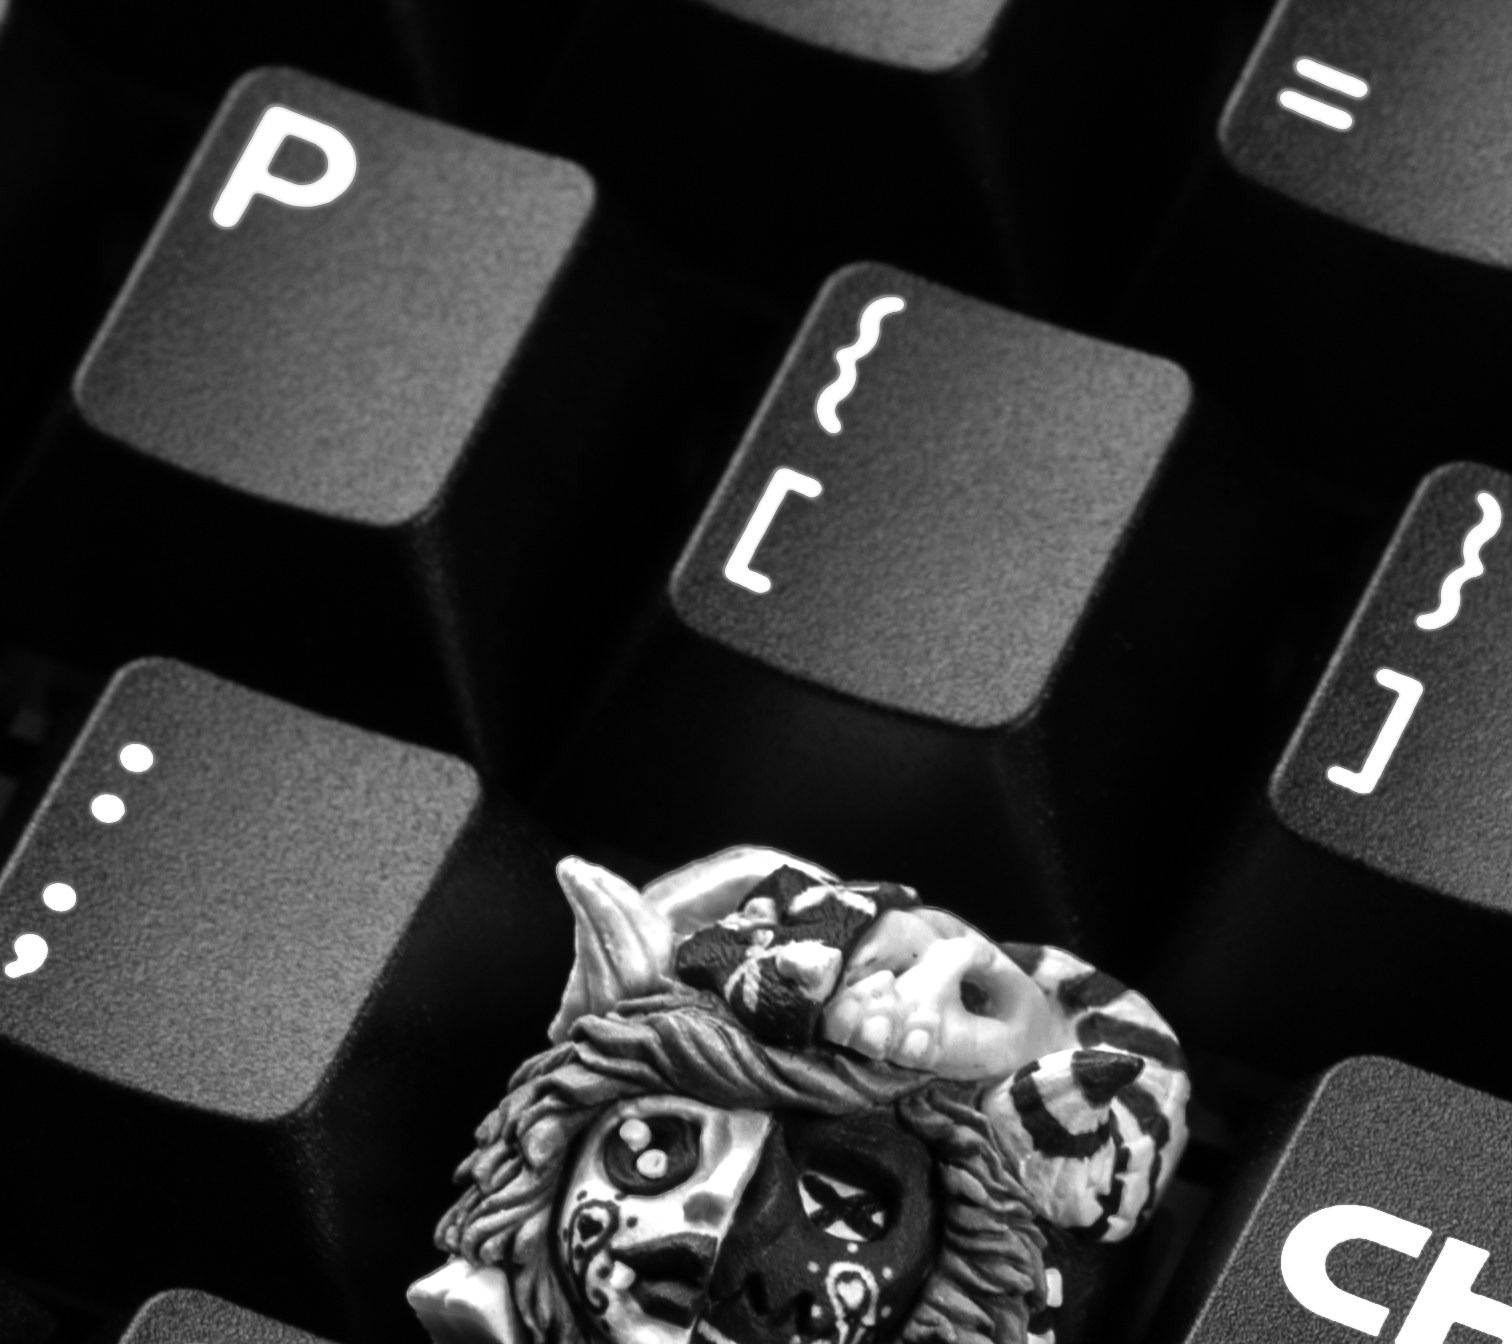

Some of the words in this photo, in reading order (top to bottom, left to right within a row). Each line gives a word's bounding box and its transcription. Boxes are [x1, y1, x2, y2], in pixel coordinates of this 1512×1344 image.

[1277, 56, 1371, 132] =
[210, 104, 360, 230] P
[814, 294, 907, 436] {
[722, 465, 825, 596] [
[1413, 490, 1505, 633] }
[88, 741, 156, 826] :
[1325, 666, 1426, 797] ]
[2, 880, 79, 981] ;
